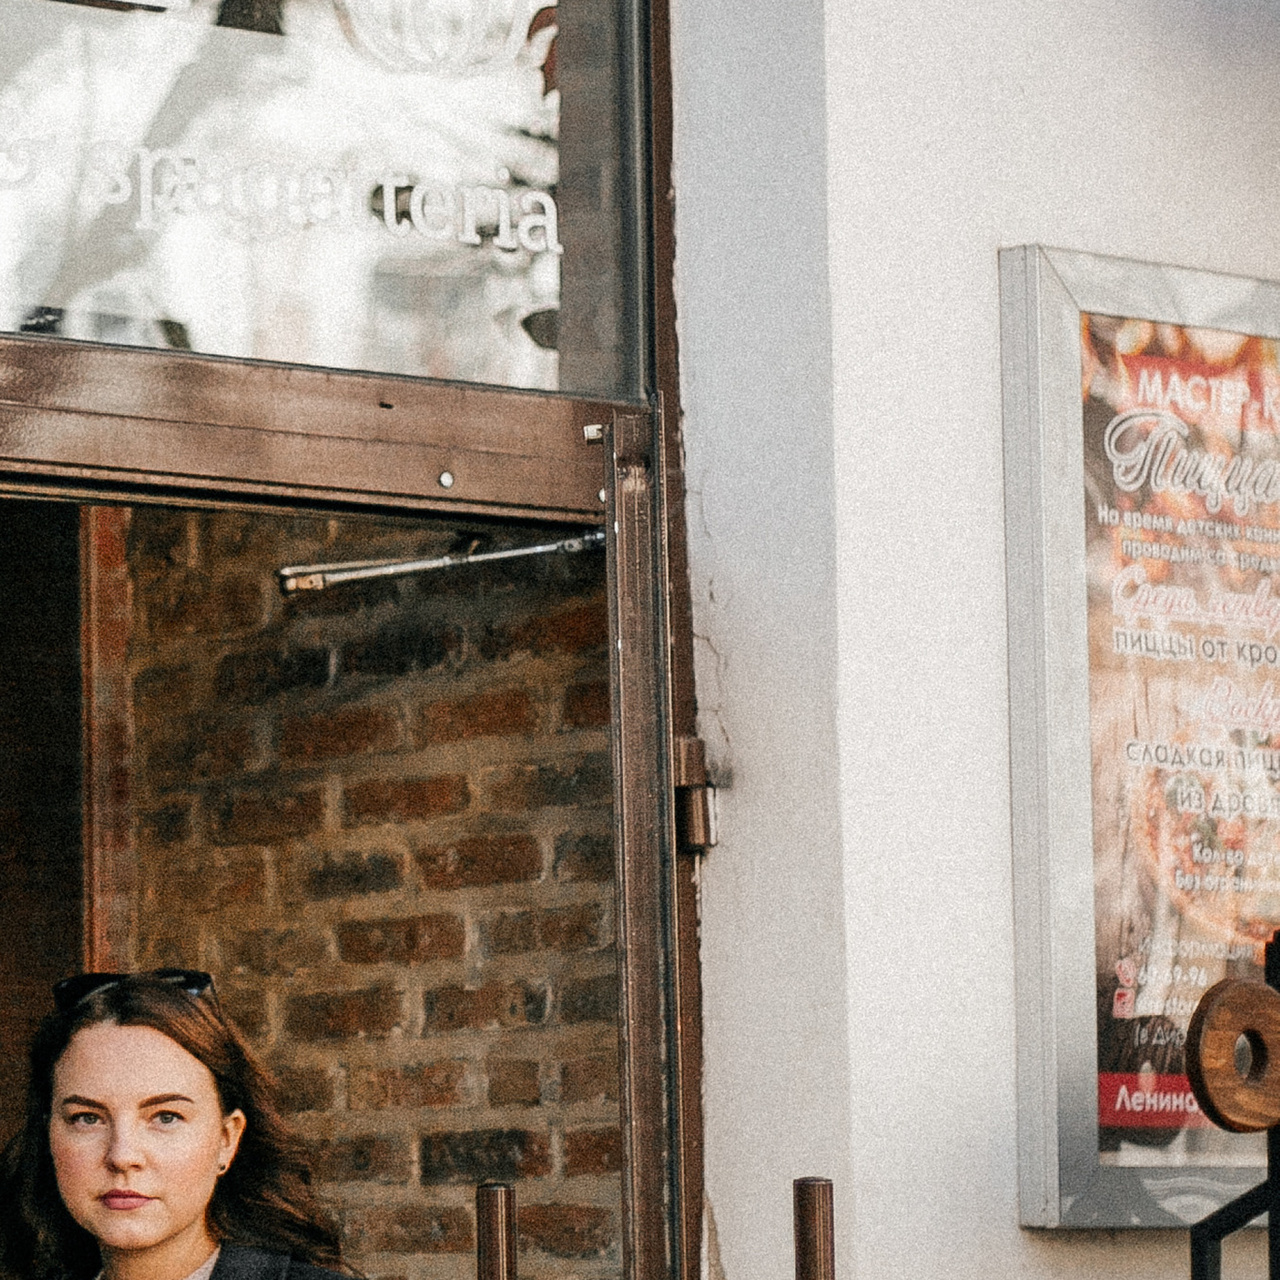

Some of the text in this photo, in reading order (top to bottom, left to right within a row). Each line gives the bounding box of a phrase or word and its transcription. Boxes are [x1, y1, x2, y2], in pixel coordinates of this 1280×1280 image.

[1115, 631, 1278, 667] пиццы от кро
[1126, 741, 1226, 768] сладкая
[1179, 791, 1203, 809] из
